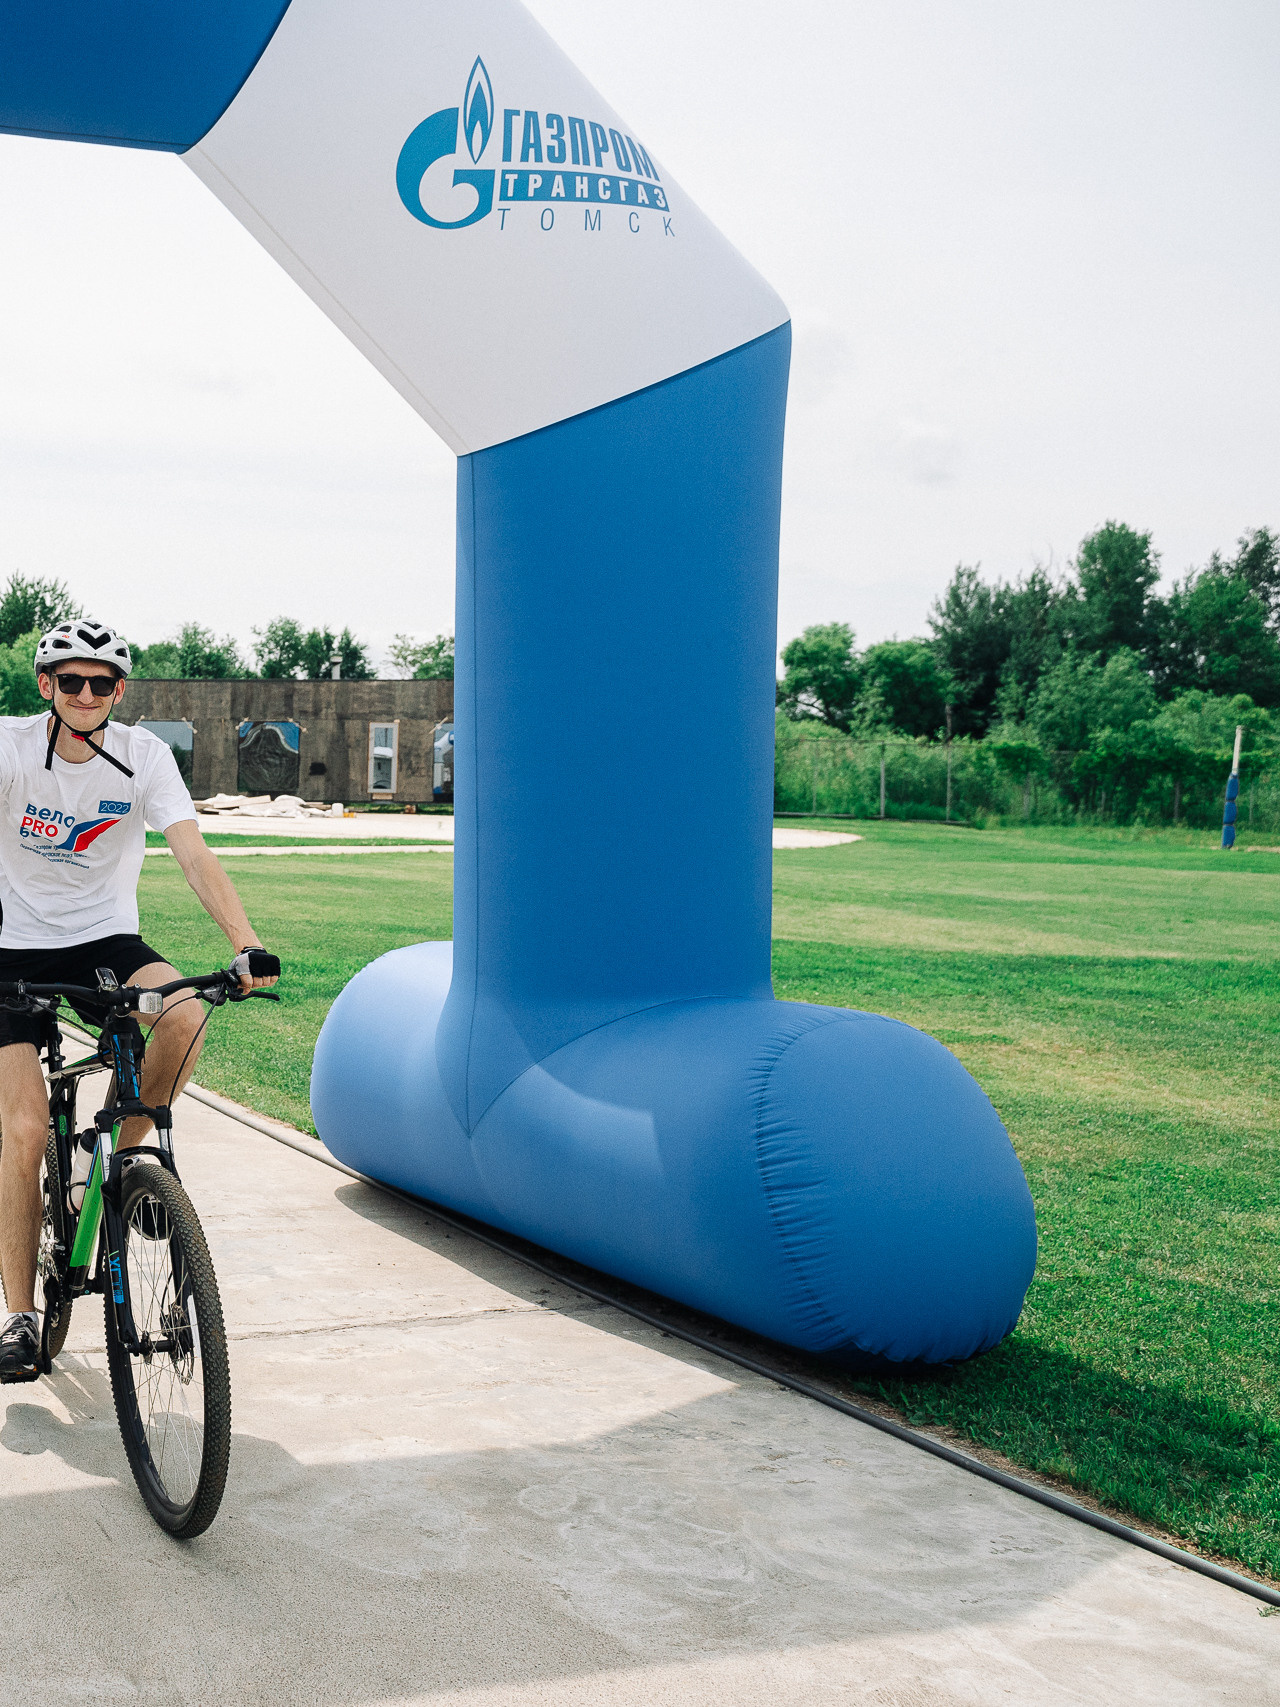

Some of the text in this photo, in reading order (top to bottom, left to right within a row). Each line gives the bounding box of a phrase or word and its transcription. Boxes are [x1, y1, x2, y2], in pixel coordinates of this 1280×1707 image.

[502, 108, 660, 182] ГАЗПРОМ
[505, 173, 666, 208] ТРАНСГАЗ
[498, 208, 675, 237] ТОМСК
[100, 802, 129, 813] 2022
[21, 815, 59, 838] PRO
